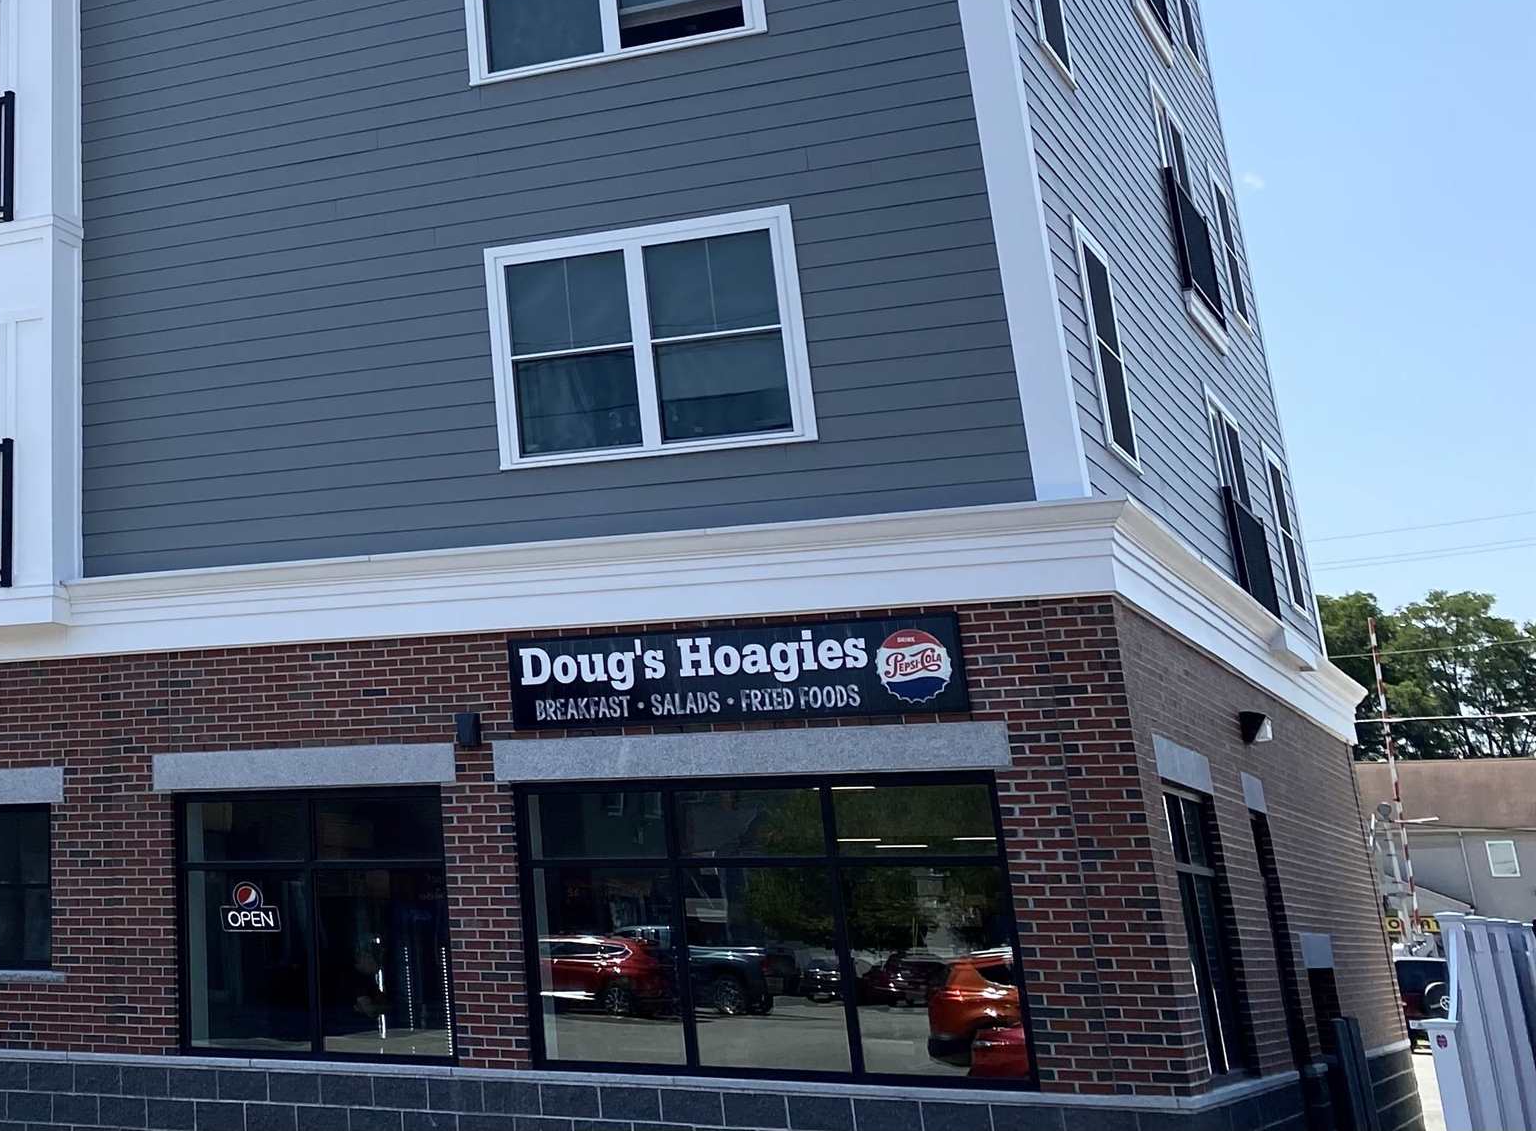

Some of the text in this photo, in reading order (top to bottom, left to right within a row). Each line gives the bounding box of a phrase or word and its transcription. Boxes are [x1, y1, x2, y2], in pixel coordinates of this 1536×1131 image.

[518, 629, 869, 691] Doug's Hoagies
[535, 684, 861, 721] BREAKFAST SALADS FRIED FOODS
[227, 911, 275, 927] OPEN
